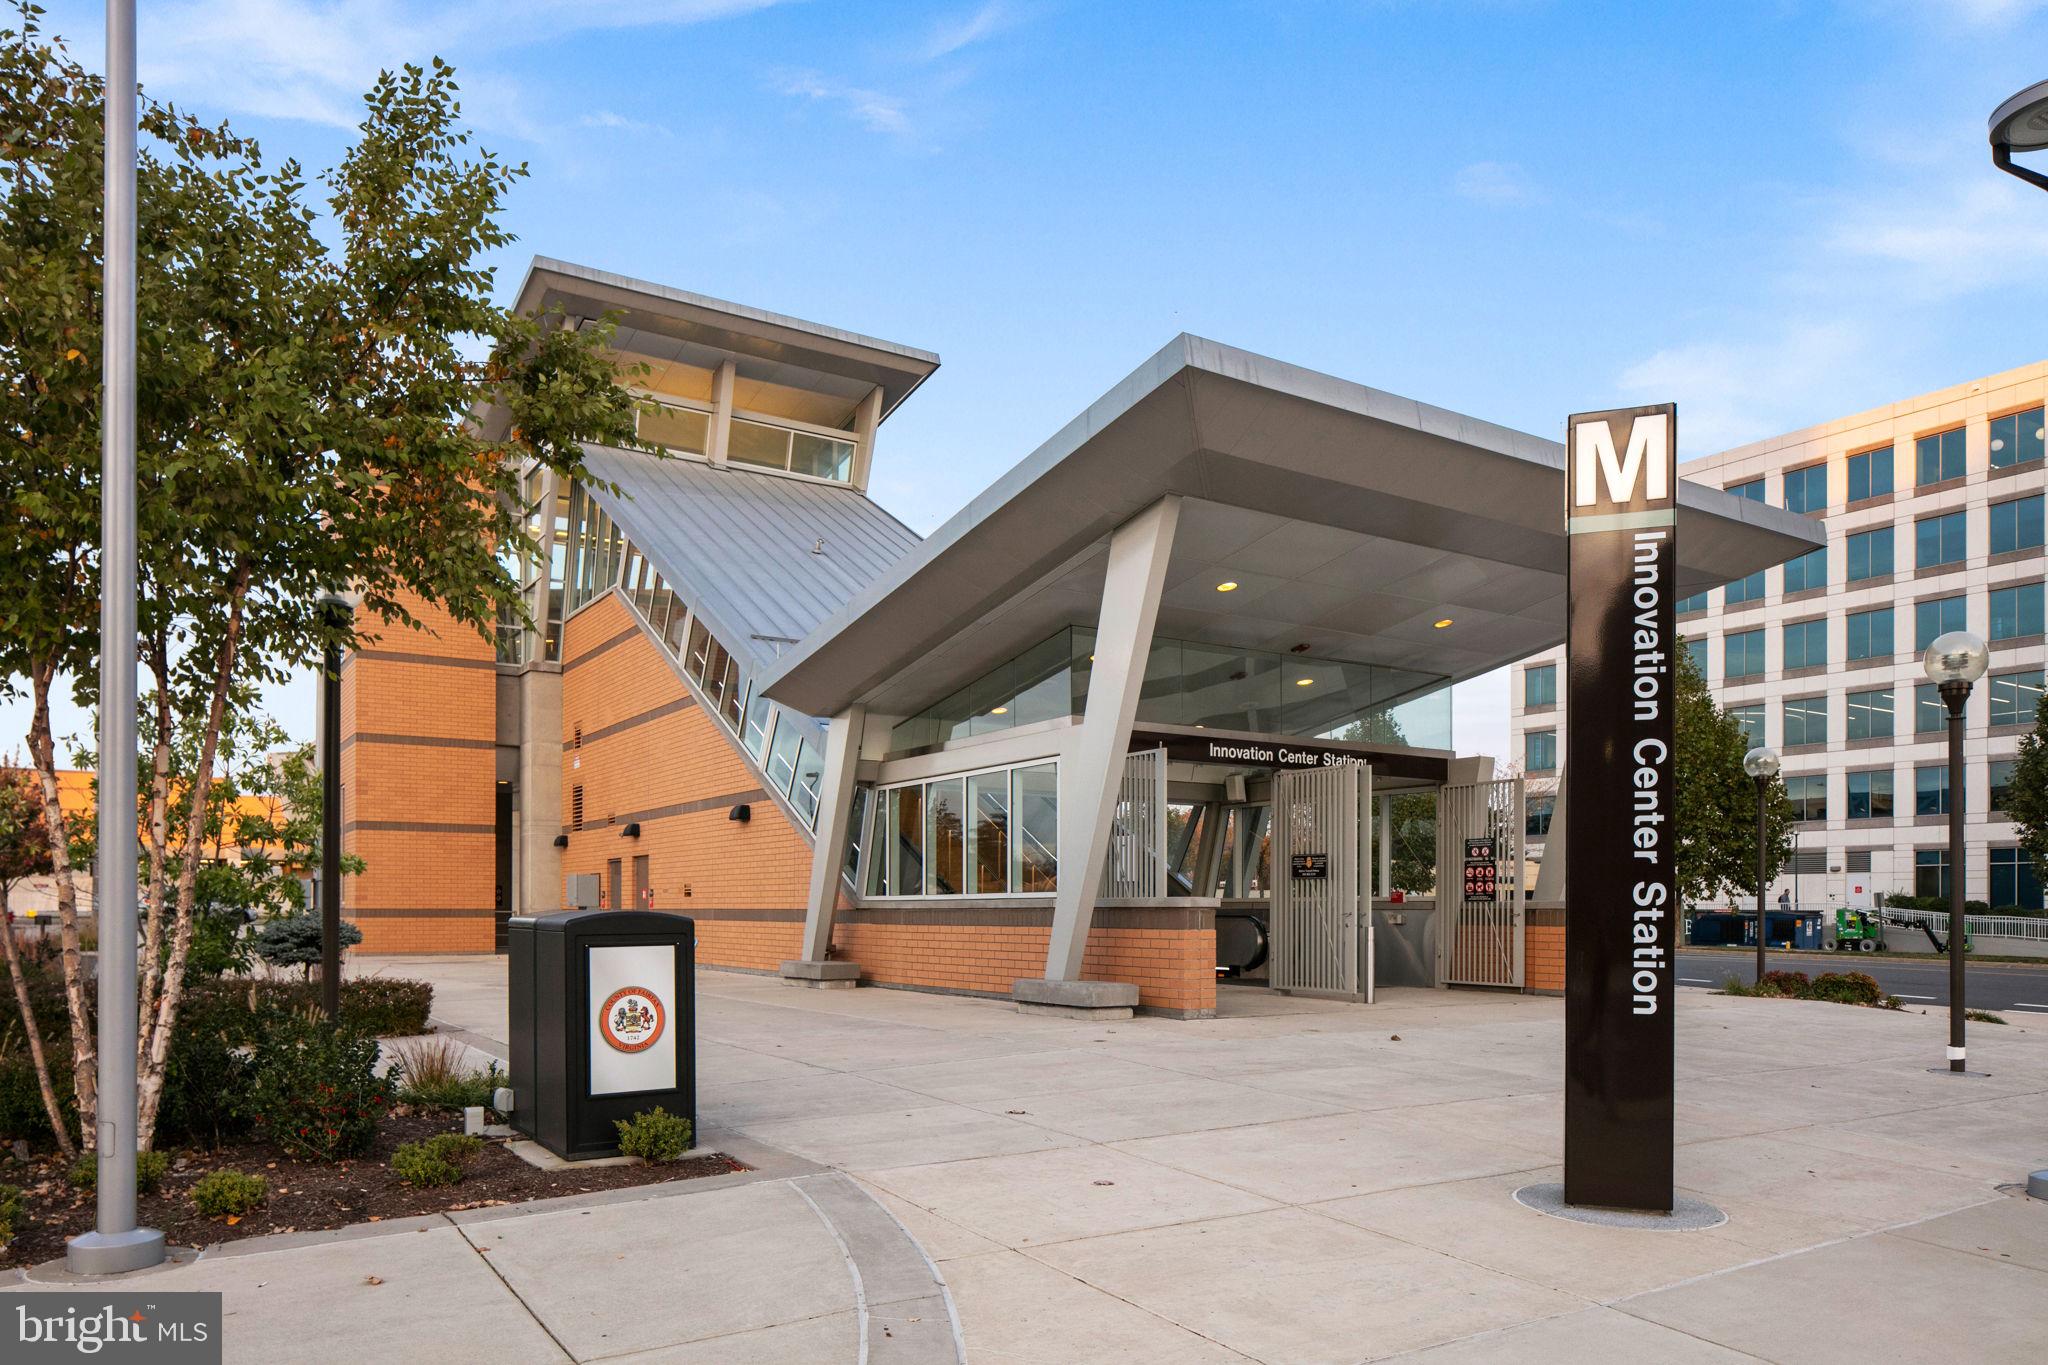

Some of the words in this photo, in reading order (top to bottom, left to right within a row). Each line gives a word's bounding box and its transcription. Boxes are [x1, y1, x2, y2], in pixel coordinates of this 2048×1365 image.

[1575, 414, 1667, 507] M
[1633, 532, 1667, 721] Innovation
[1209, 743, 1274, 762] Innovation
[1278, 749, 1319, 765] Center
[1633, 738, 1668, 864] Center
[1632, 881, 1667, 1015] Station
